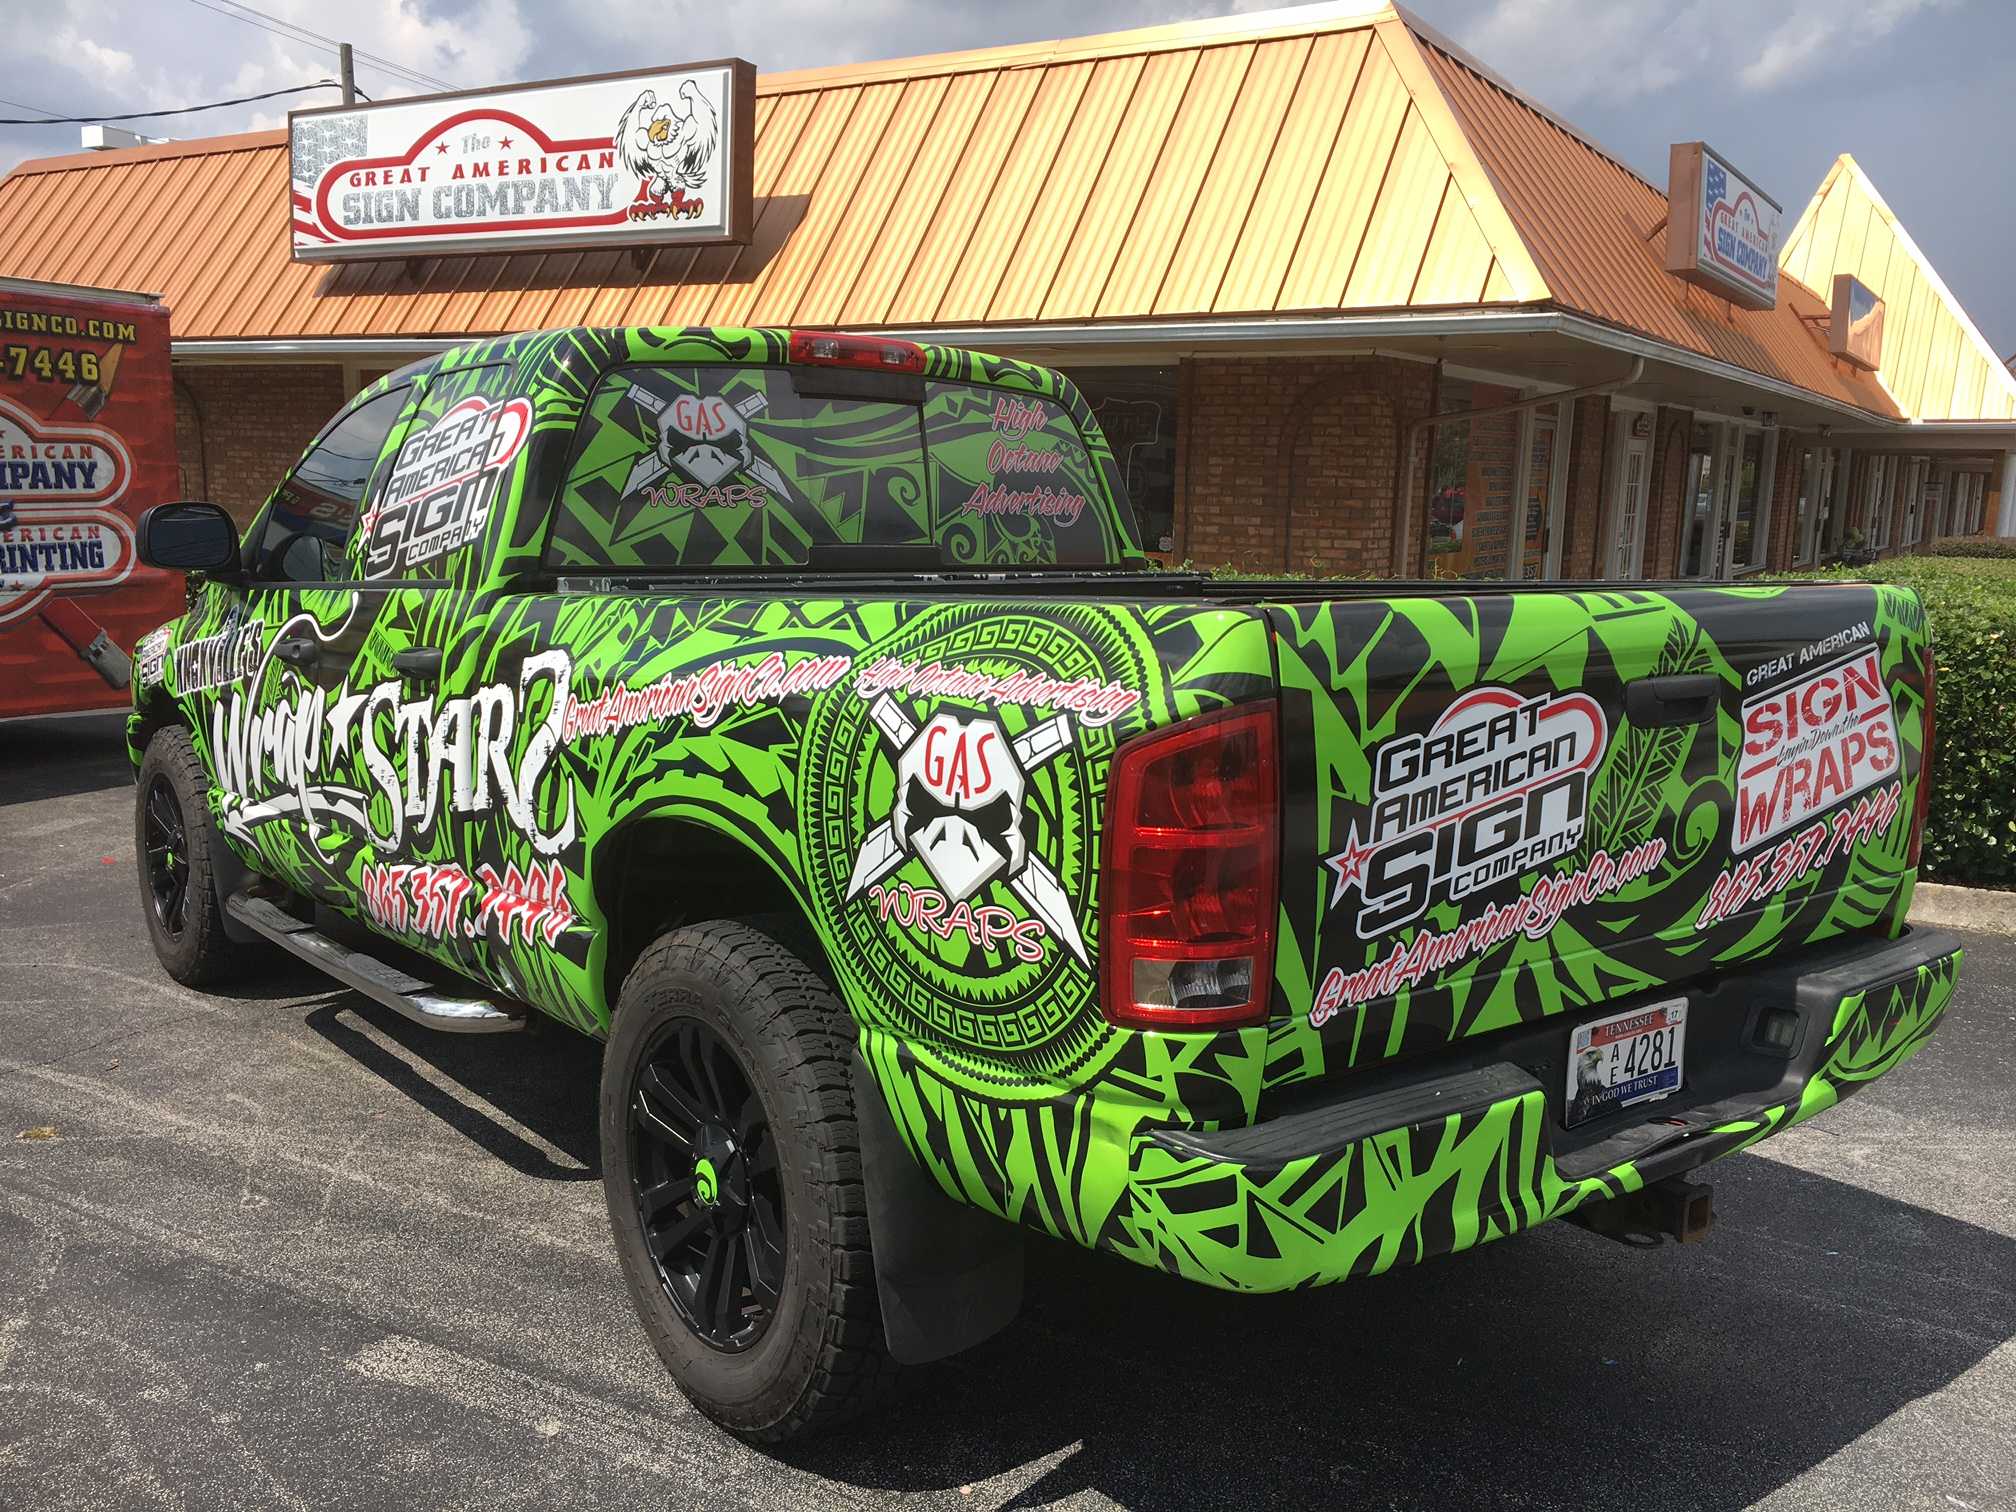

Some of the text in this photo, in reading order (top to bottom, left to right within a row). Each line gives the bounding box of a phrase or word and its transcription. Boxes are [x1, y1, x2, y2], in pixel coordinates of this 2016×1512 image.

[349, 151, 615, 188] GREAT AMERICAN
[461, 132, 492, 155] The
[343, 173, 618, 226] SIGN COMPANY
[1718, 226, 1737, 260] SIGN
[0, 311, 136, 341] IGNCO.COM
[396, 405, 503, 471] GREAT
[675, 400, 726, 436] GAS
[989, 397, 1048, 441] High
[384, 432, 504, 508] AMERICAN
[987, 439, 1063, 474] Octane
[365, 467, 499, 579] SIGN
[641, 482, 767, 508] WRAPS
[962, 482, 1086, 527] Advertising
[408, 515, 484, 562] COMPANY
[1746, 621, 1870, 687] GREAT AMERICAN
[854, 656, 1141, 727] High Octane Advertising
[1744, 656, 1880, 754] SIGN
[924, 726, 995, 799] GAS
[1379, 699, 1548, 794] GREAT
[1376, 731, 1577, 842] AMERICAN
[1739, 721, 1896, 845] WRAPS
[1359, 771, 1587, 935] SIGN
[1453, 824, 1582, 893] COMPANY
[1695, 780, 1901, 929] 865.357.7446
[869, 883, 1045, 962] WRAPS
[1605, 1013, 1655, 1037] TENNESSEE
[1624, 1027, 1676, 1078] 4281
[1592, 1075, 1658, 1105] IN GOD WE TRUST
